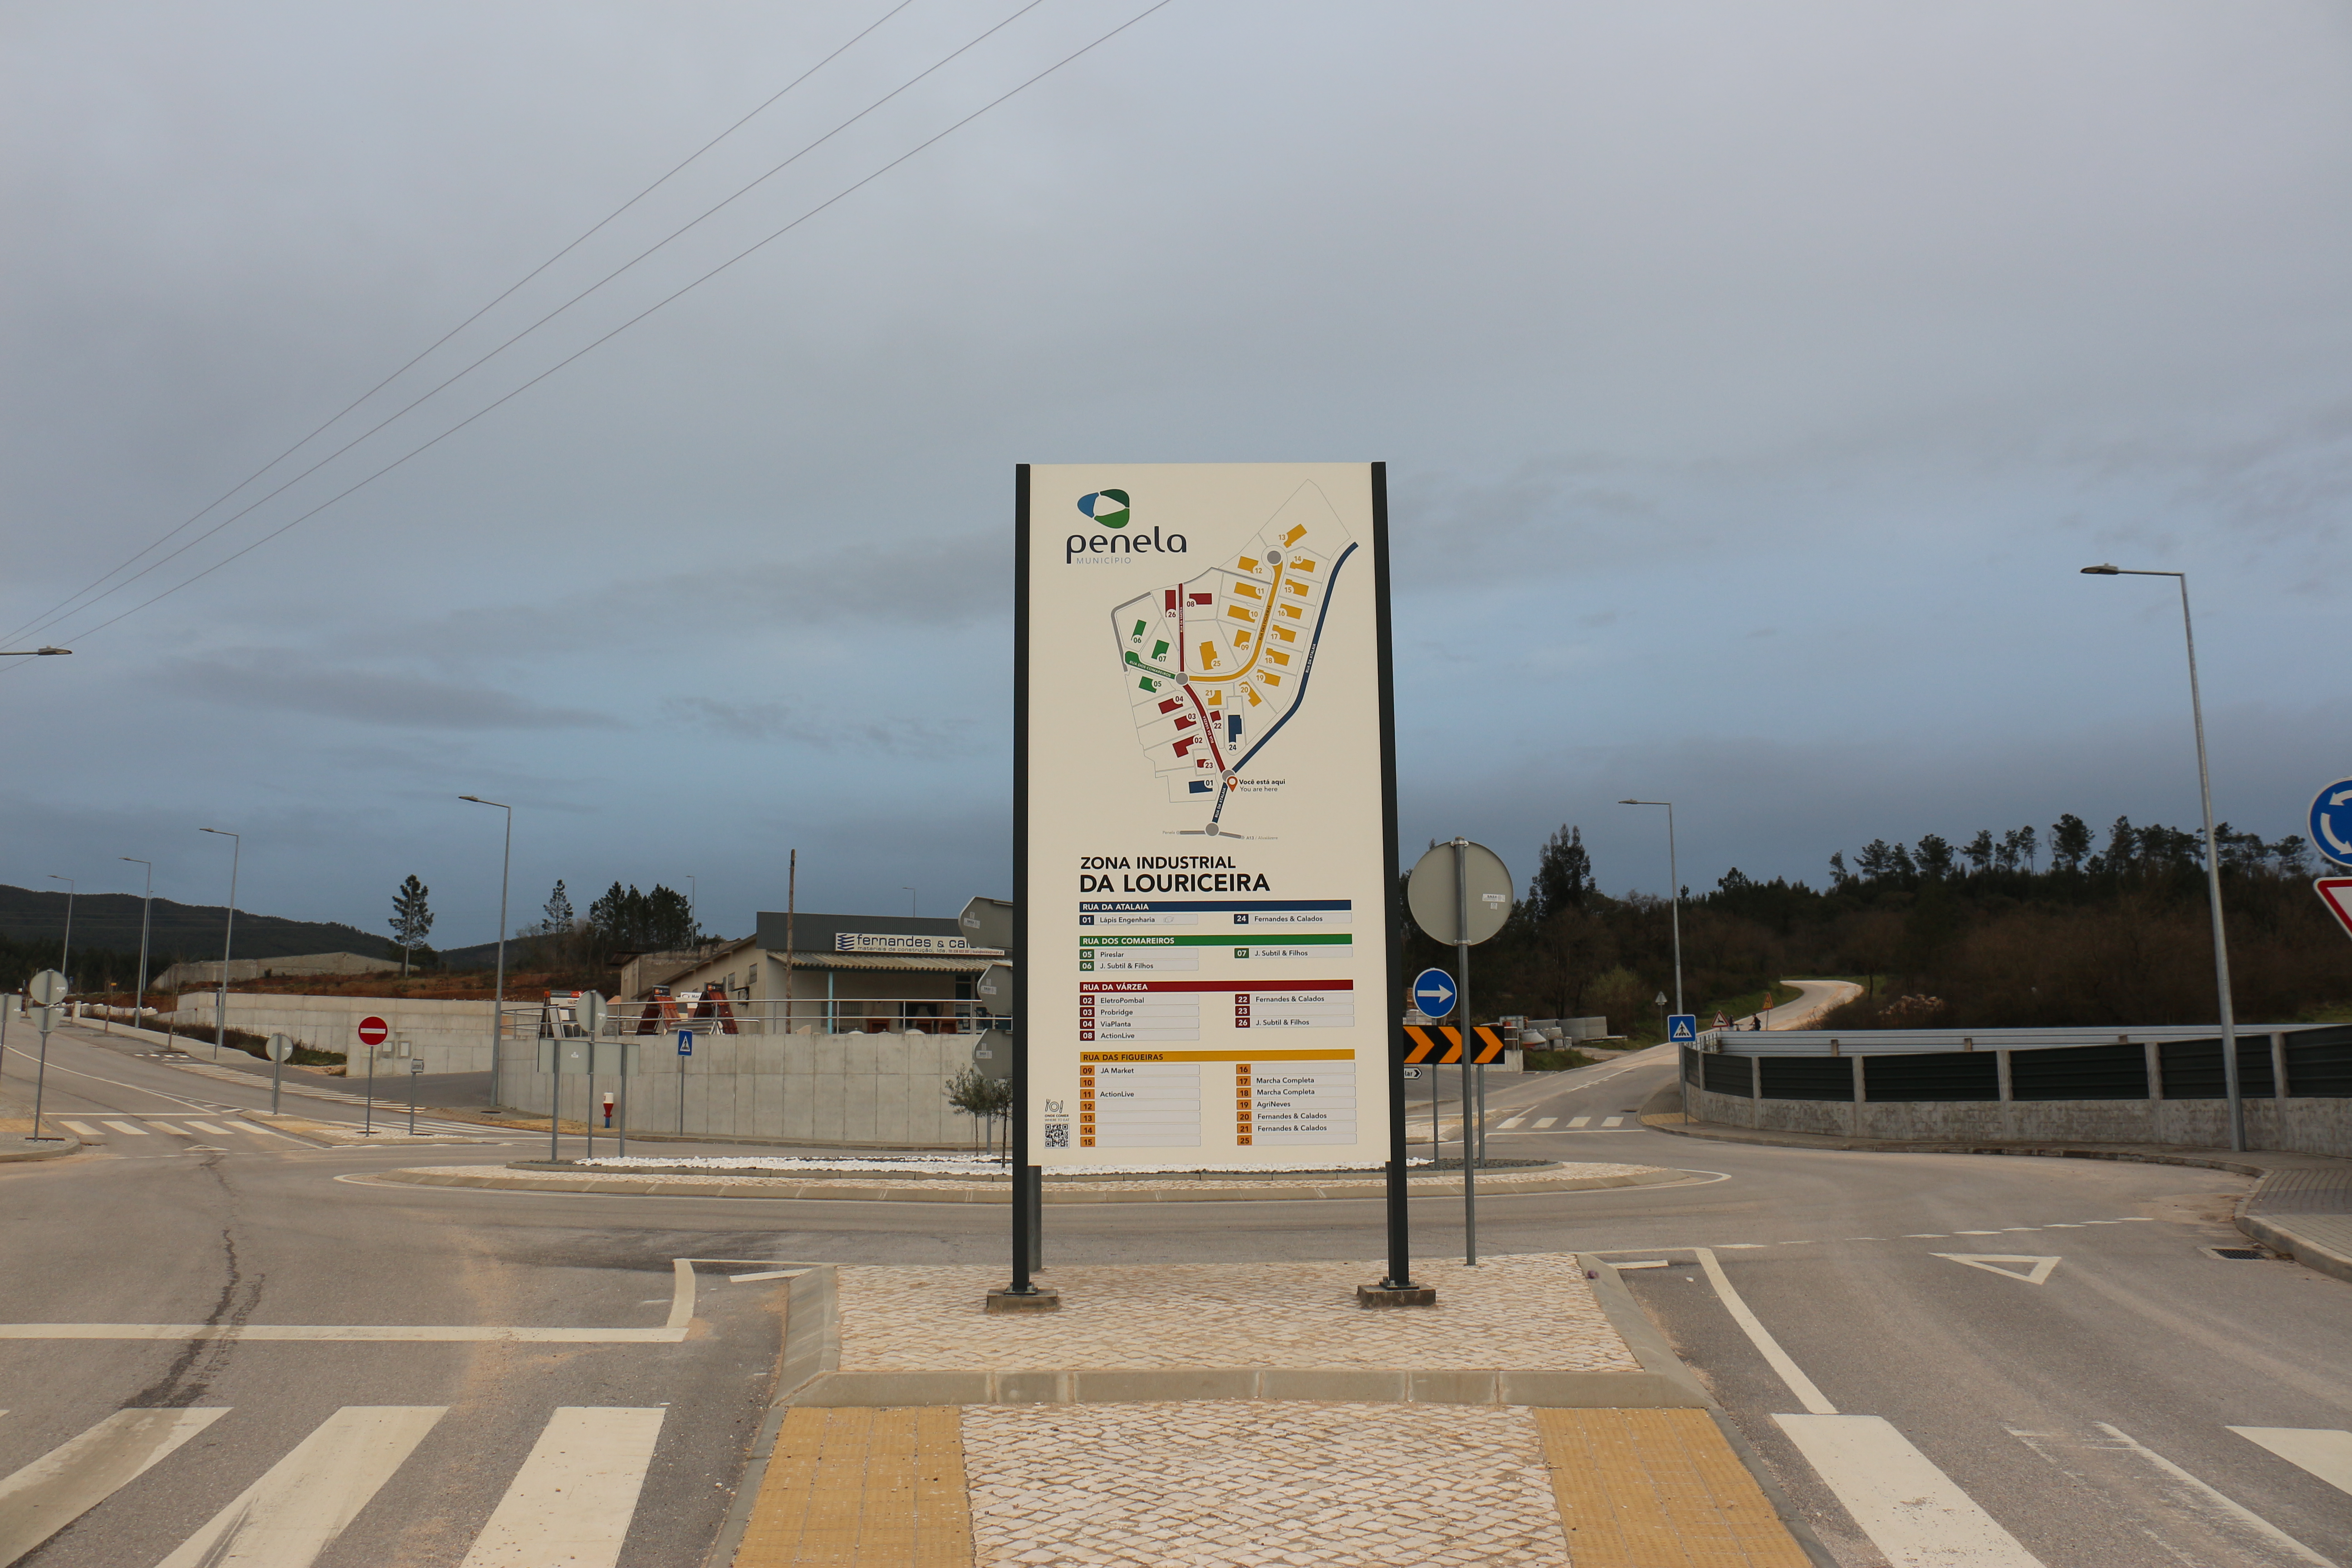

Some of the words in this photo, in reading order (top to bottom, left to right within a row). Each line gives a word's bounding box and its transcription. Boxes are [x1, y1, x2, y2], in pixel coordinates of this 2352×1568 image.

[1067, 526, 1186, 564] penela
[1077, 556, 1131, 564] MUNICÍPIO
[1147, 666, 1171, 677] COMAREIROS
[1081, 857, 1130, 869] ZONA
[1137, 856, 1235, 869] INDUSTRIAL
[1081, 875, 1114, 892] DA
[1124, 874, 1270, 892] LOURICEIRA
[857, 934, 931, 947] fernandes
